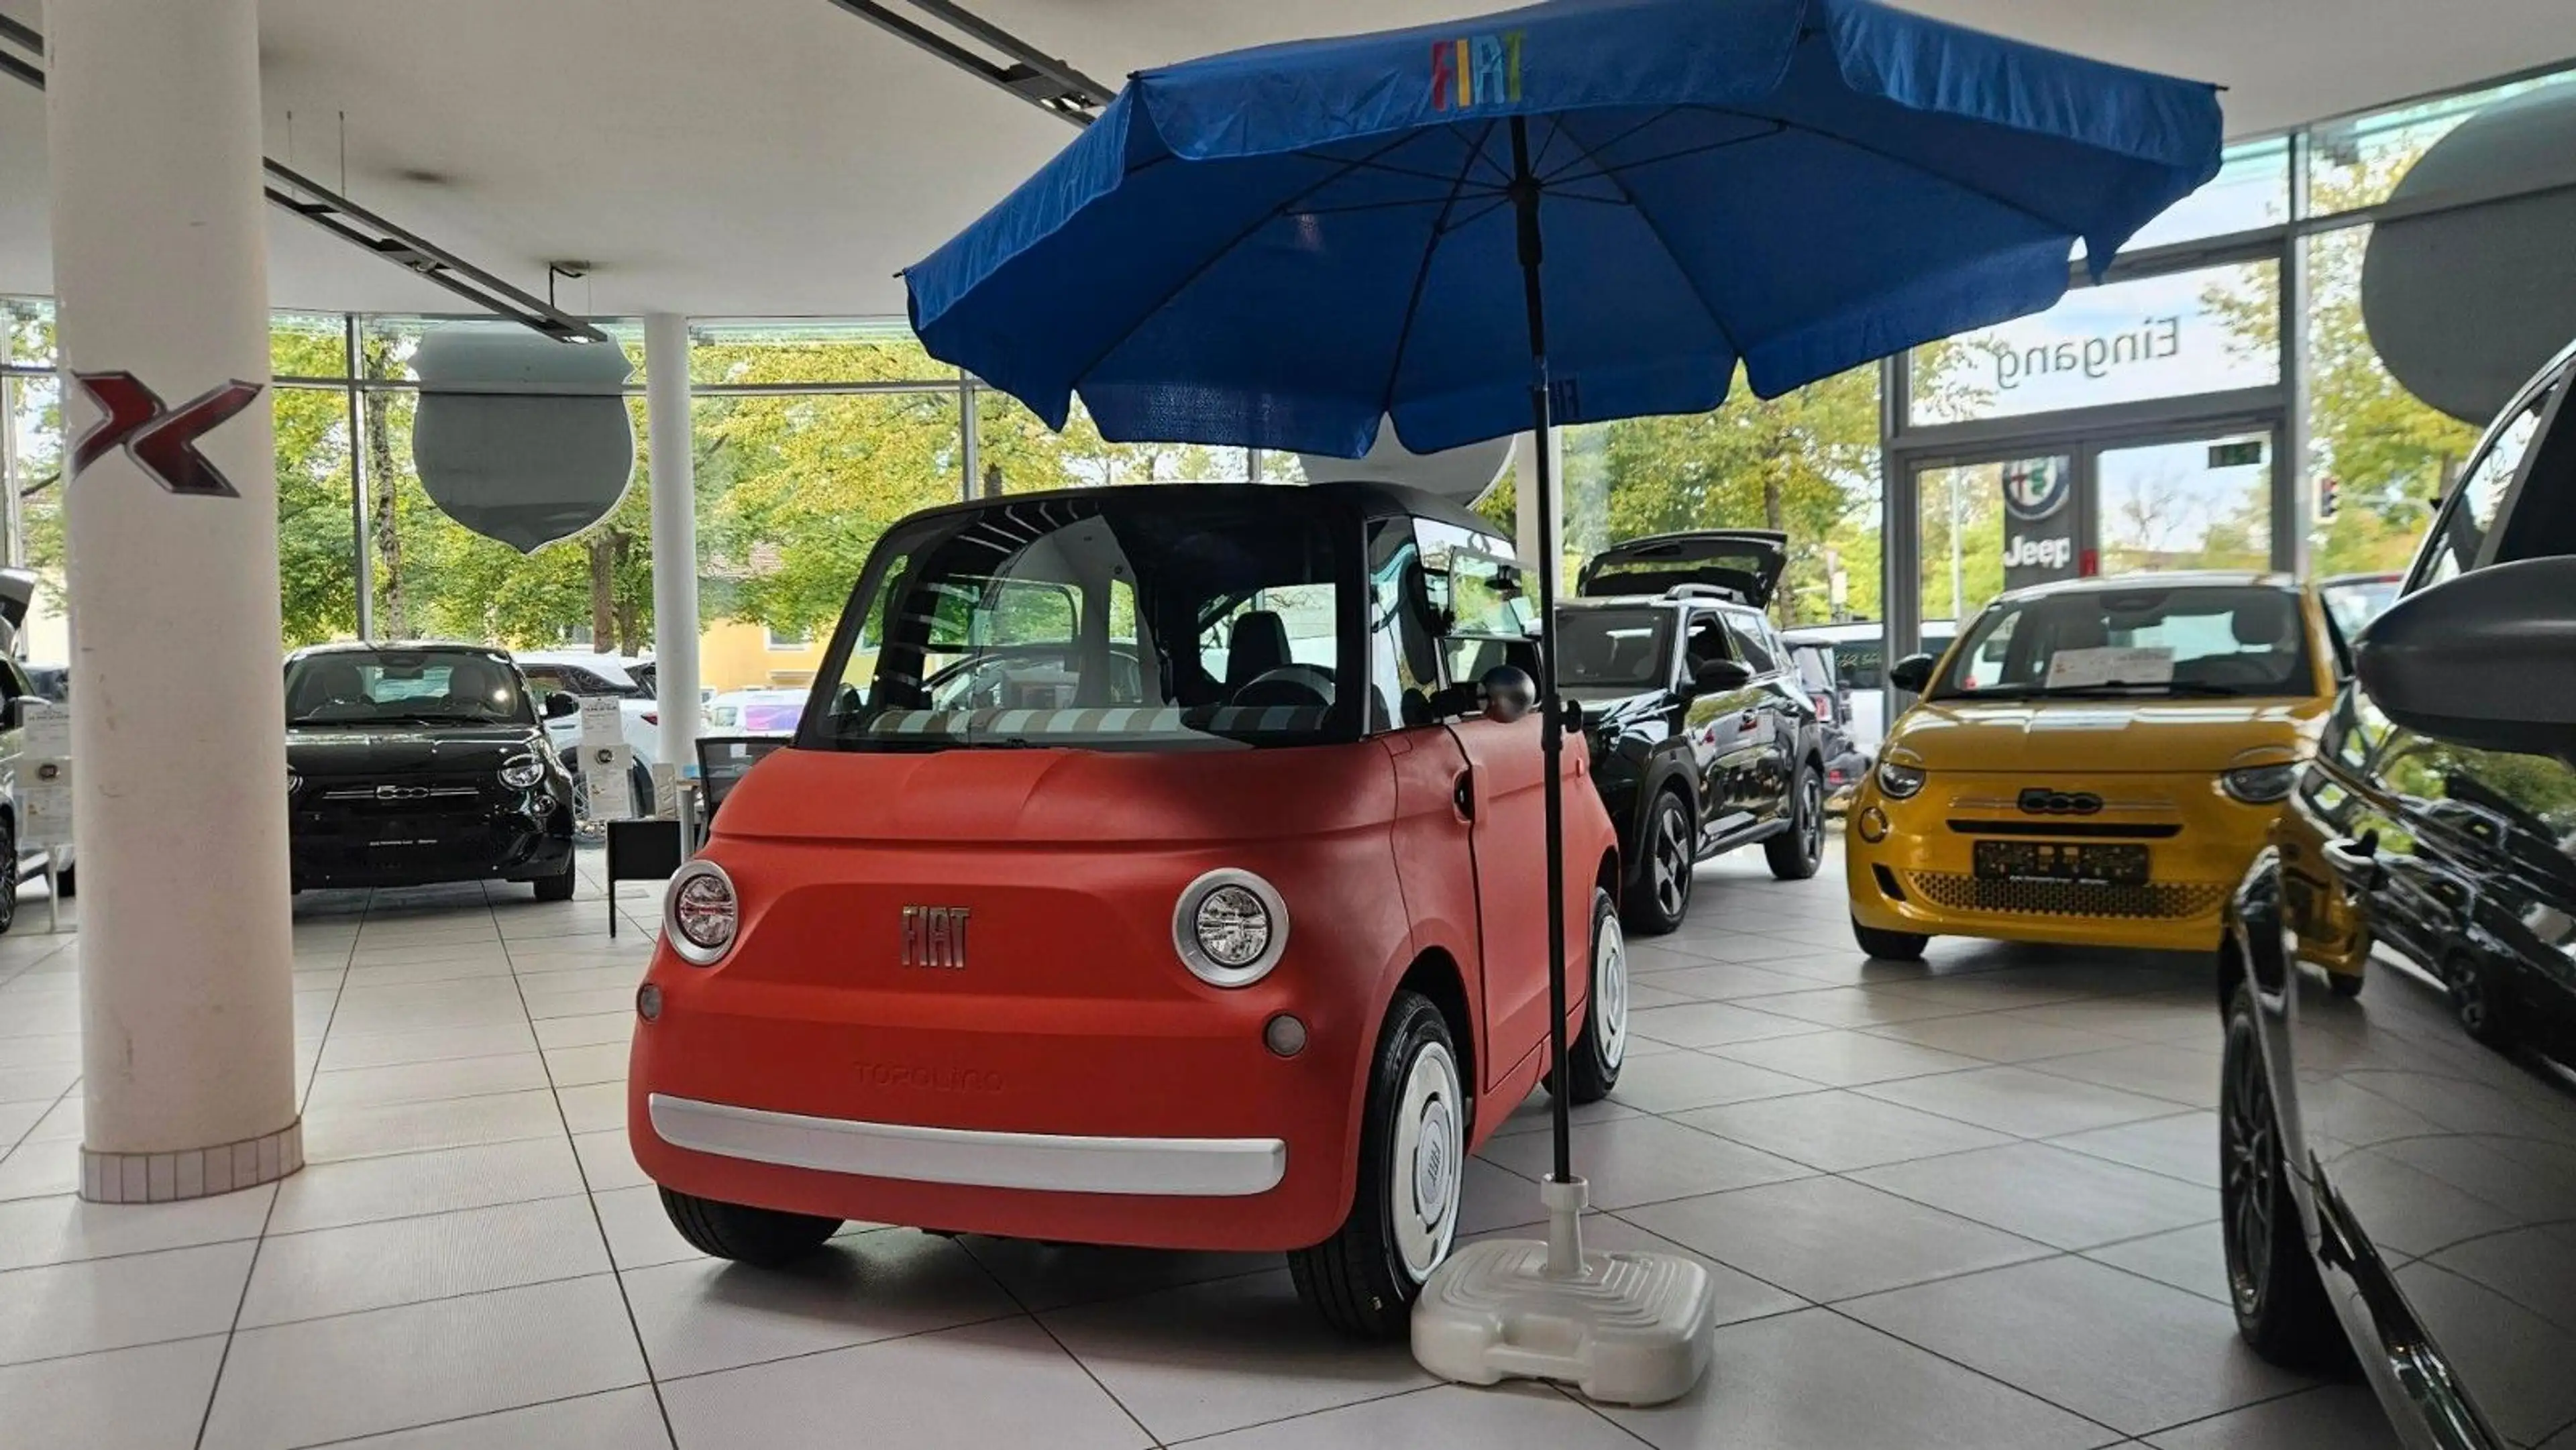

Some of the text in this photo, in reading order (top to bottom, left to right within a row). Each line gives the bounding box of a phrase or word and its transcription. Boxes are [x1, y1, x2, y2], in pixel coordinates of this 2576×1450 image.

[1432, 30, 1527, 113] FIAT
[2003, 535, 2071, 568] Jeep
[376, 785, 429, 799] 500
[2017, 788, 2104, 815] 500
[902, 906, 970, 968] FIAT
